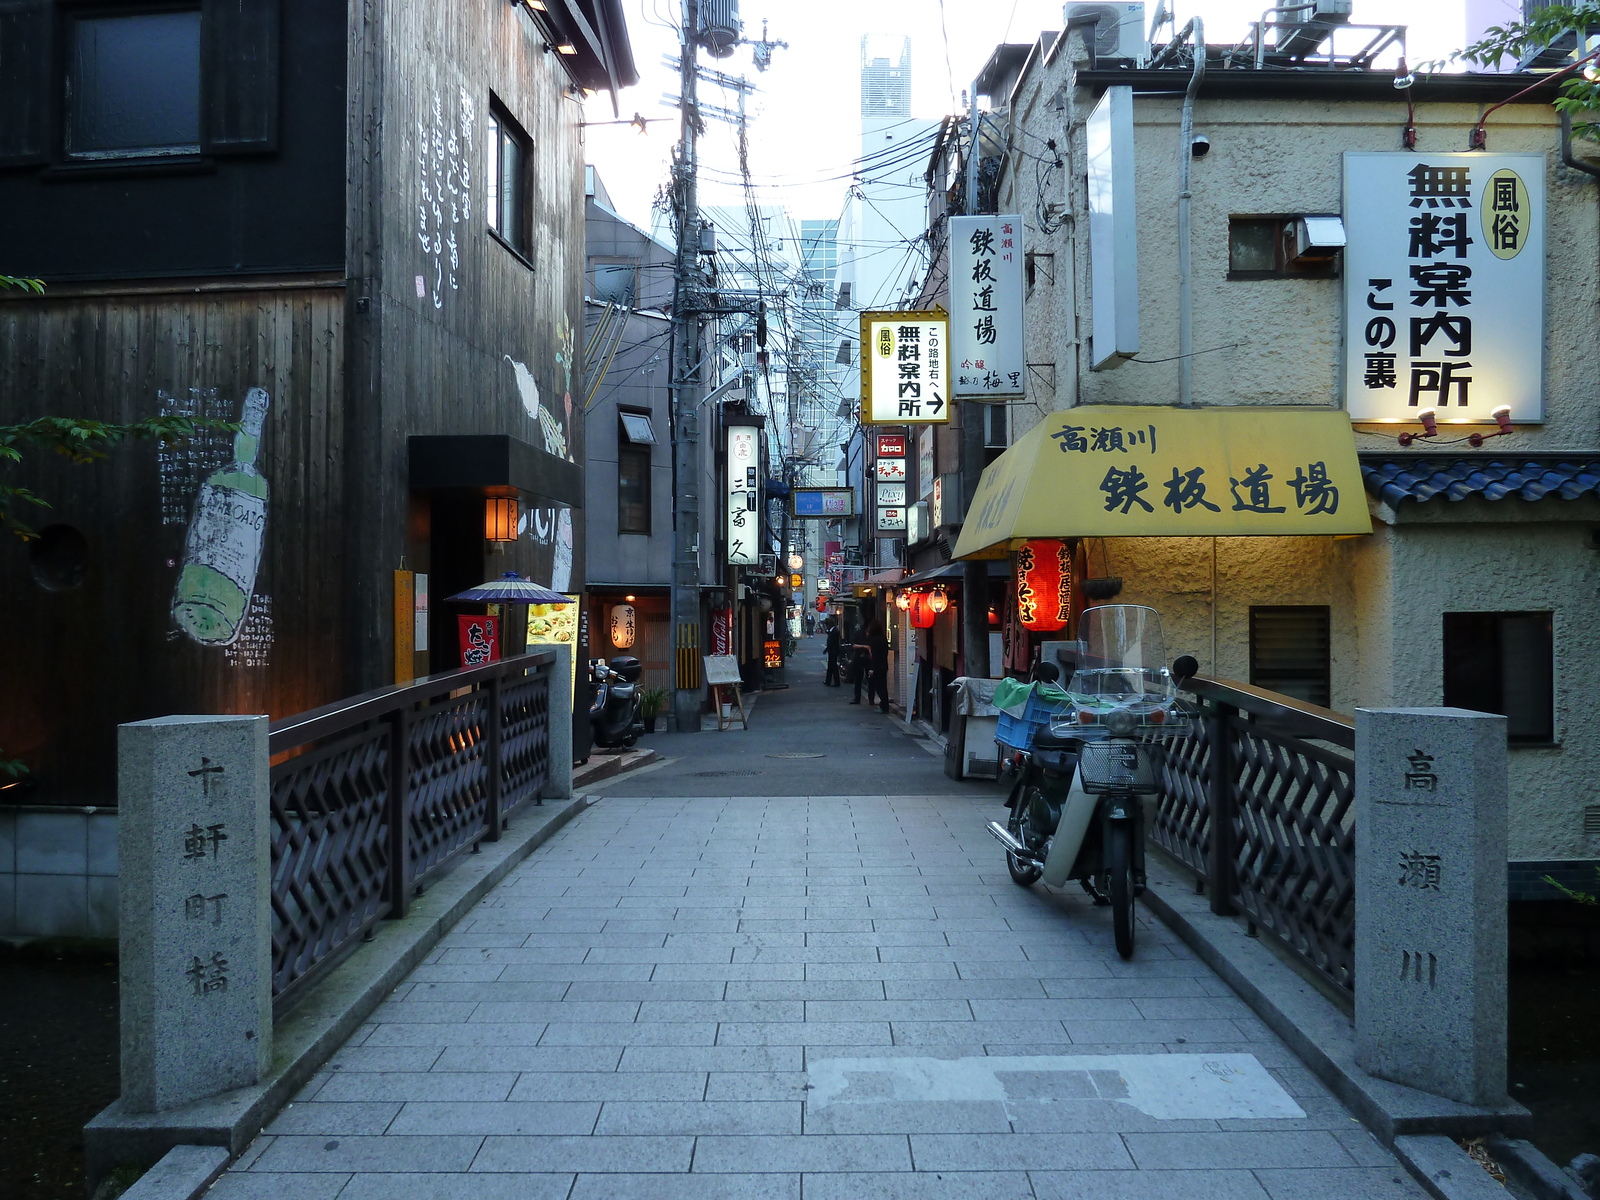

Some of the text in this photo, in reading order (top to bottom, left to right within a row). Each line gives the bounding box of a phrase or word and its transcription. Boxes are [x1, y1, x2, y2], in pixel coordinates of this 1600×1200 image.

[1001, 223, 1014, 264] 高瀬川
[1491, 177, 1520, 250] 風俗
[969, 228, 998, 346] 鉄板道場
[1407, 163, 1474, 407] 無料案内所
[880, 329, 891, 357] 風俗
[928, 327, 939, 389] この路地右へ
[1363, 278, 1397, 389] この裏
[897, 325, 922, 417] 無料案内所
[878, 466, 905, 477] チャチャ
[1050, 424, 1157, 454] 高瀬川
[1099, 461, 1339, 515] 鉄板道場
[1018, 547, 1037, 622] 焼きそば
[1057, 545, 1071, 621] 鉄板居酒屋
[764, 654, 781, 662] ワイン
[183, 756, 229, 996] 十軒町橋
[1397, 748, 1442, 991] 高瀬川
